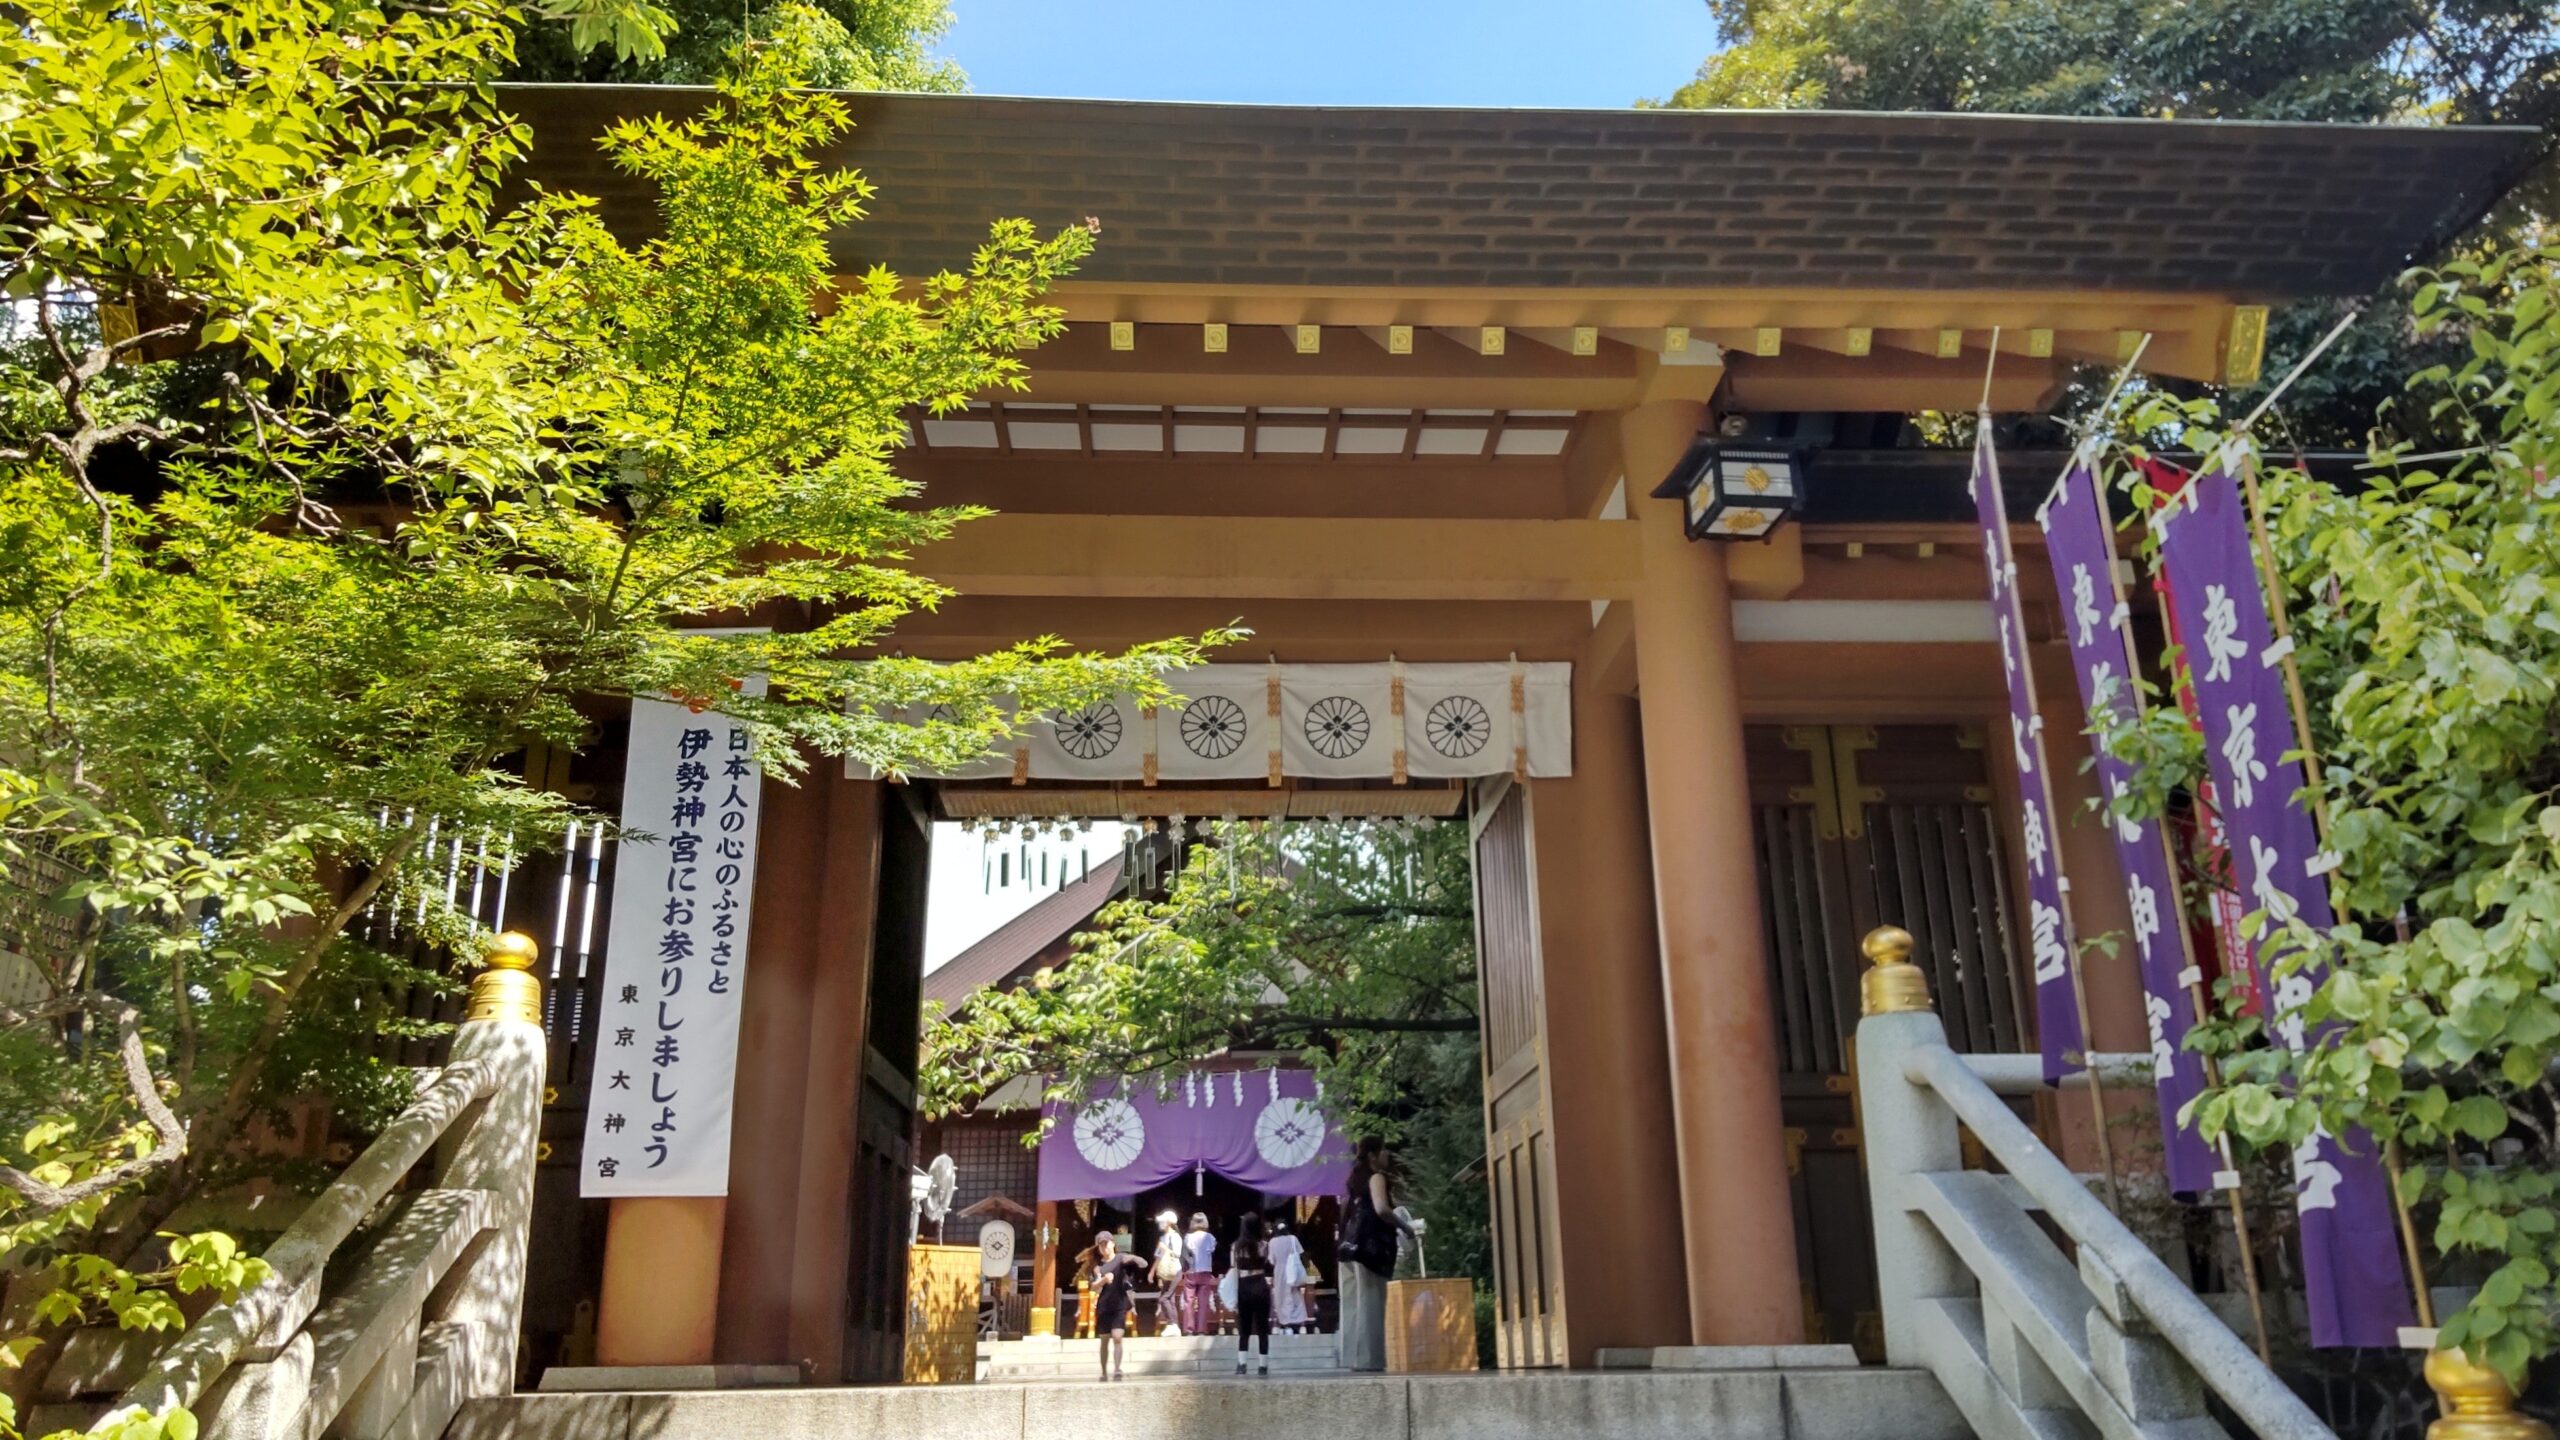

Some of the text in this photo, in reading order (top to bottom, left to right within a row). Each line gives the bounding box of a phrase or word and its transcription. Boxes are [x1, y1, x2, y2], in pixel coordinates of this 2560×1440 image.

[643, 727, 714, 1169] 伊勢神宮にお参りしましょう
[707, 728, 751, 995] 日本人の心のふるさと
[597, 983, 640, 1179] 東京大神宮
